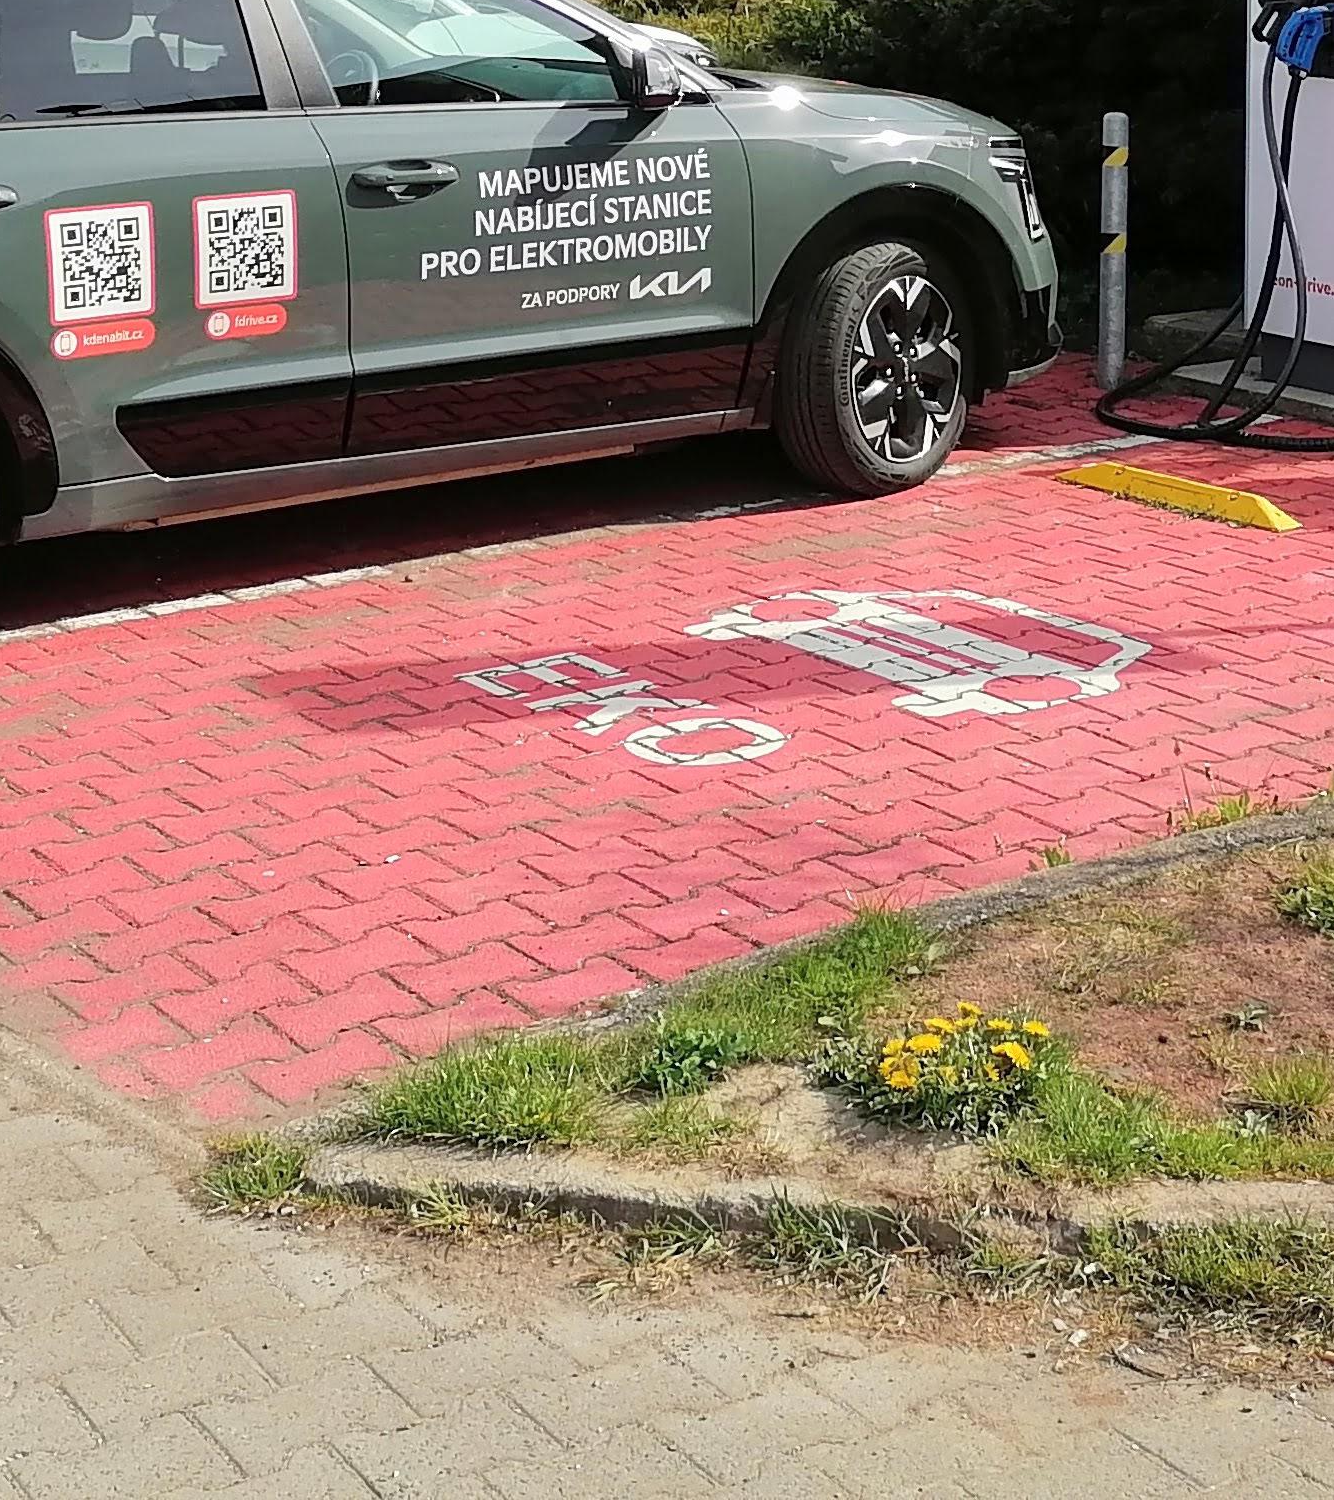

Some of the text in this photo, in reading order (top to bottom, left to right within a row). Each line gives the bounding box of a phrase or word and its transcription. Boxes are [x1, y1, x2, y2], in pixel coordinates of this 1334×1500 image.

[478, 147, 711, 199] MAPUJEME NOVÉ
[474, 188, 713, 237] NABÍJECÍ STANICE
[420, 224, 712, 280] PRO ELEKTROMOBILY
[521, 267, 712, 309] ZA PODPORY KIA
[83, 329, 145, 347] kdenabit.cz
[234, 315, 278, 328] fdrive.cz
[453, 651, 788, 766] EKO
